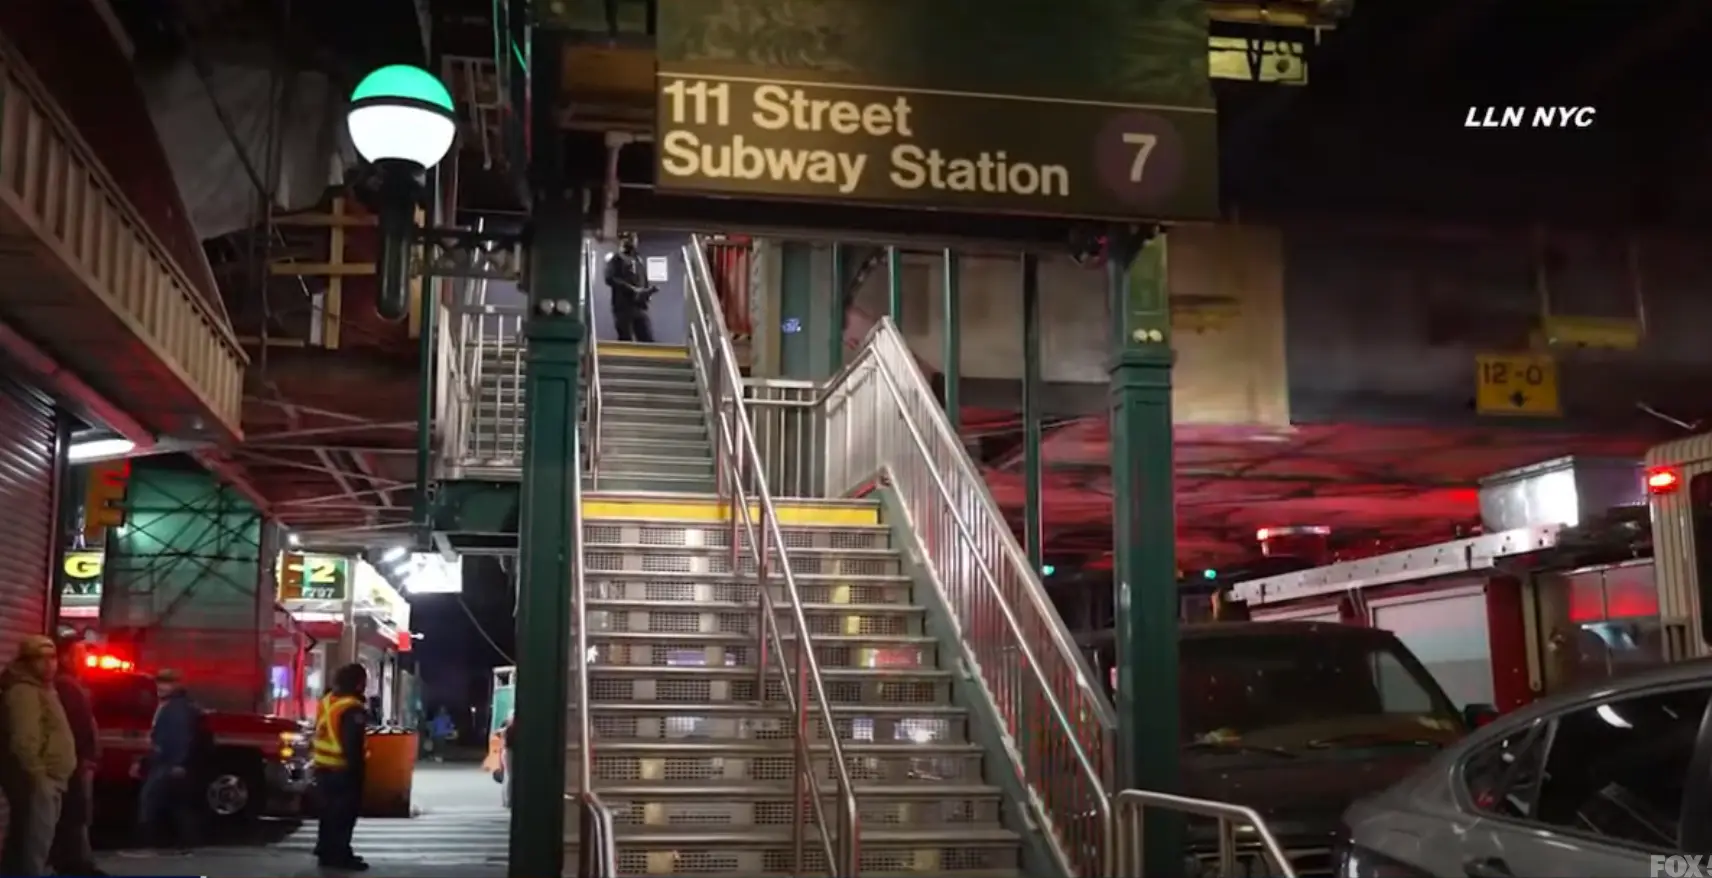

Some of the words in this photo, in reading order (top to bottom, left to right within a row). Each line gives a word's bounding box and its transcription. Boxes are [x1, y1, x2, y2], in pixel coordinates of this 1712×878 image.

[663, 80, 729, 126] 111
[752, 84, 912, 137] Street
[662, 130, 867, 193] Subway
[889, 144, 1069, 196] Station
[1122, 133, 1157, 182] 7
